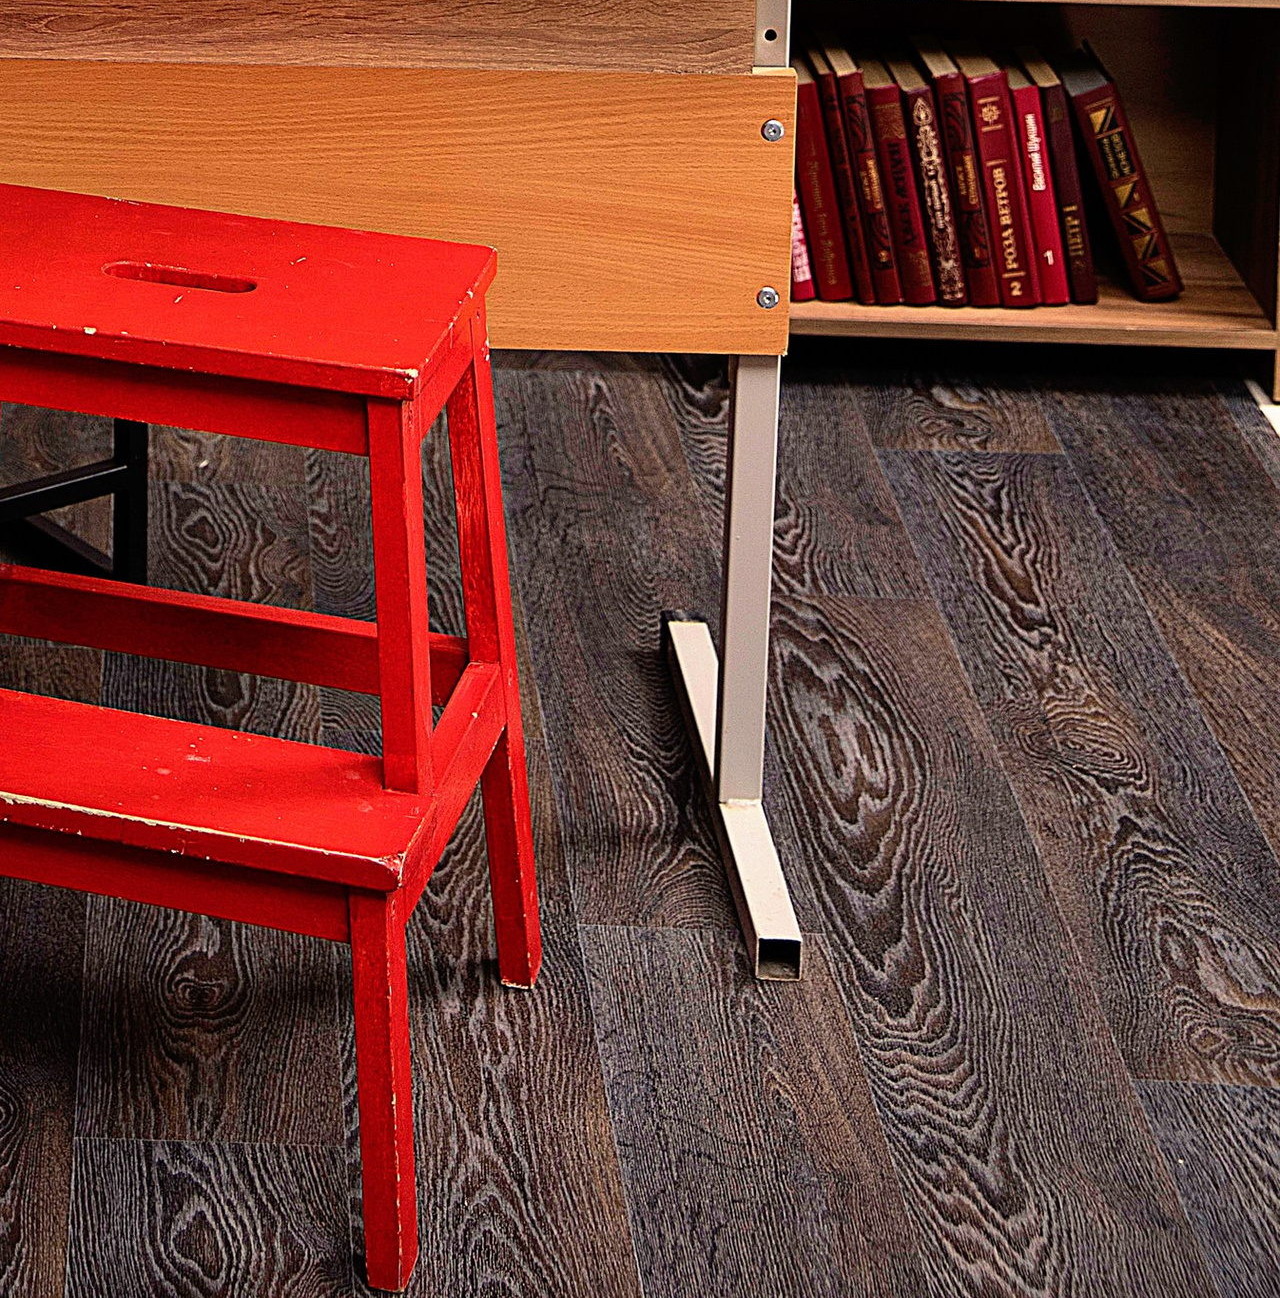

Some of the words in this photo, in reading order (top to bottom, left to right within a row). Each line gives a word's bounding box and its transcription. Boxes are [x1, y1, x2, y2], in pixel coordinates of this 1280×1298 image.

[1023, 113, 1042, 153] Шукшин
[1028, 152, 1046, 191] Василий
[991, 167, 1013, 226] ВЕТРОВ
[1001, 227, 1019, 270] РОЗА
[1043, 250, 1054, 266] 1
[1009, 281, 1021, 297] 2
